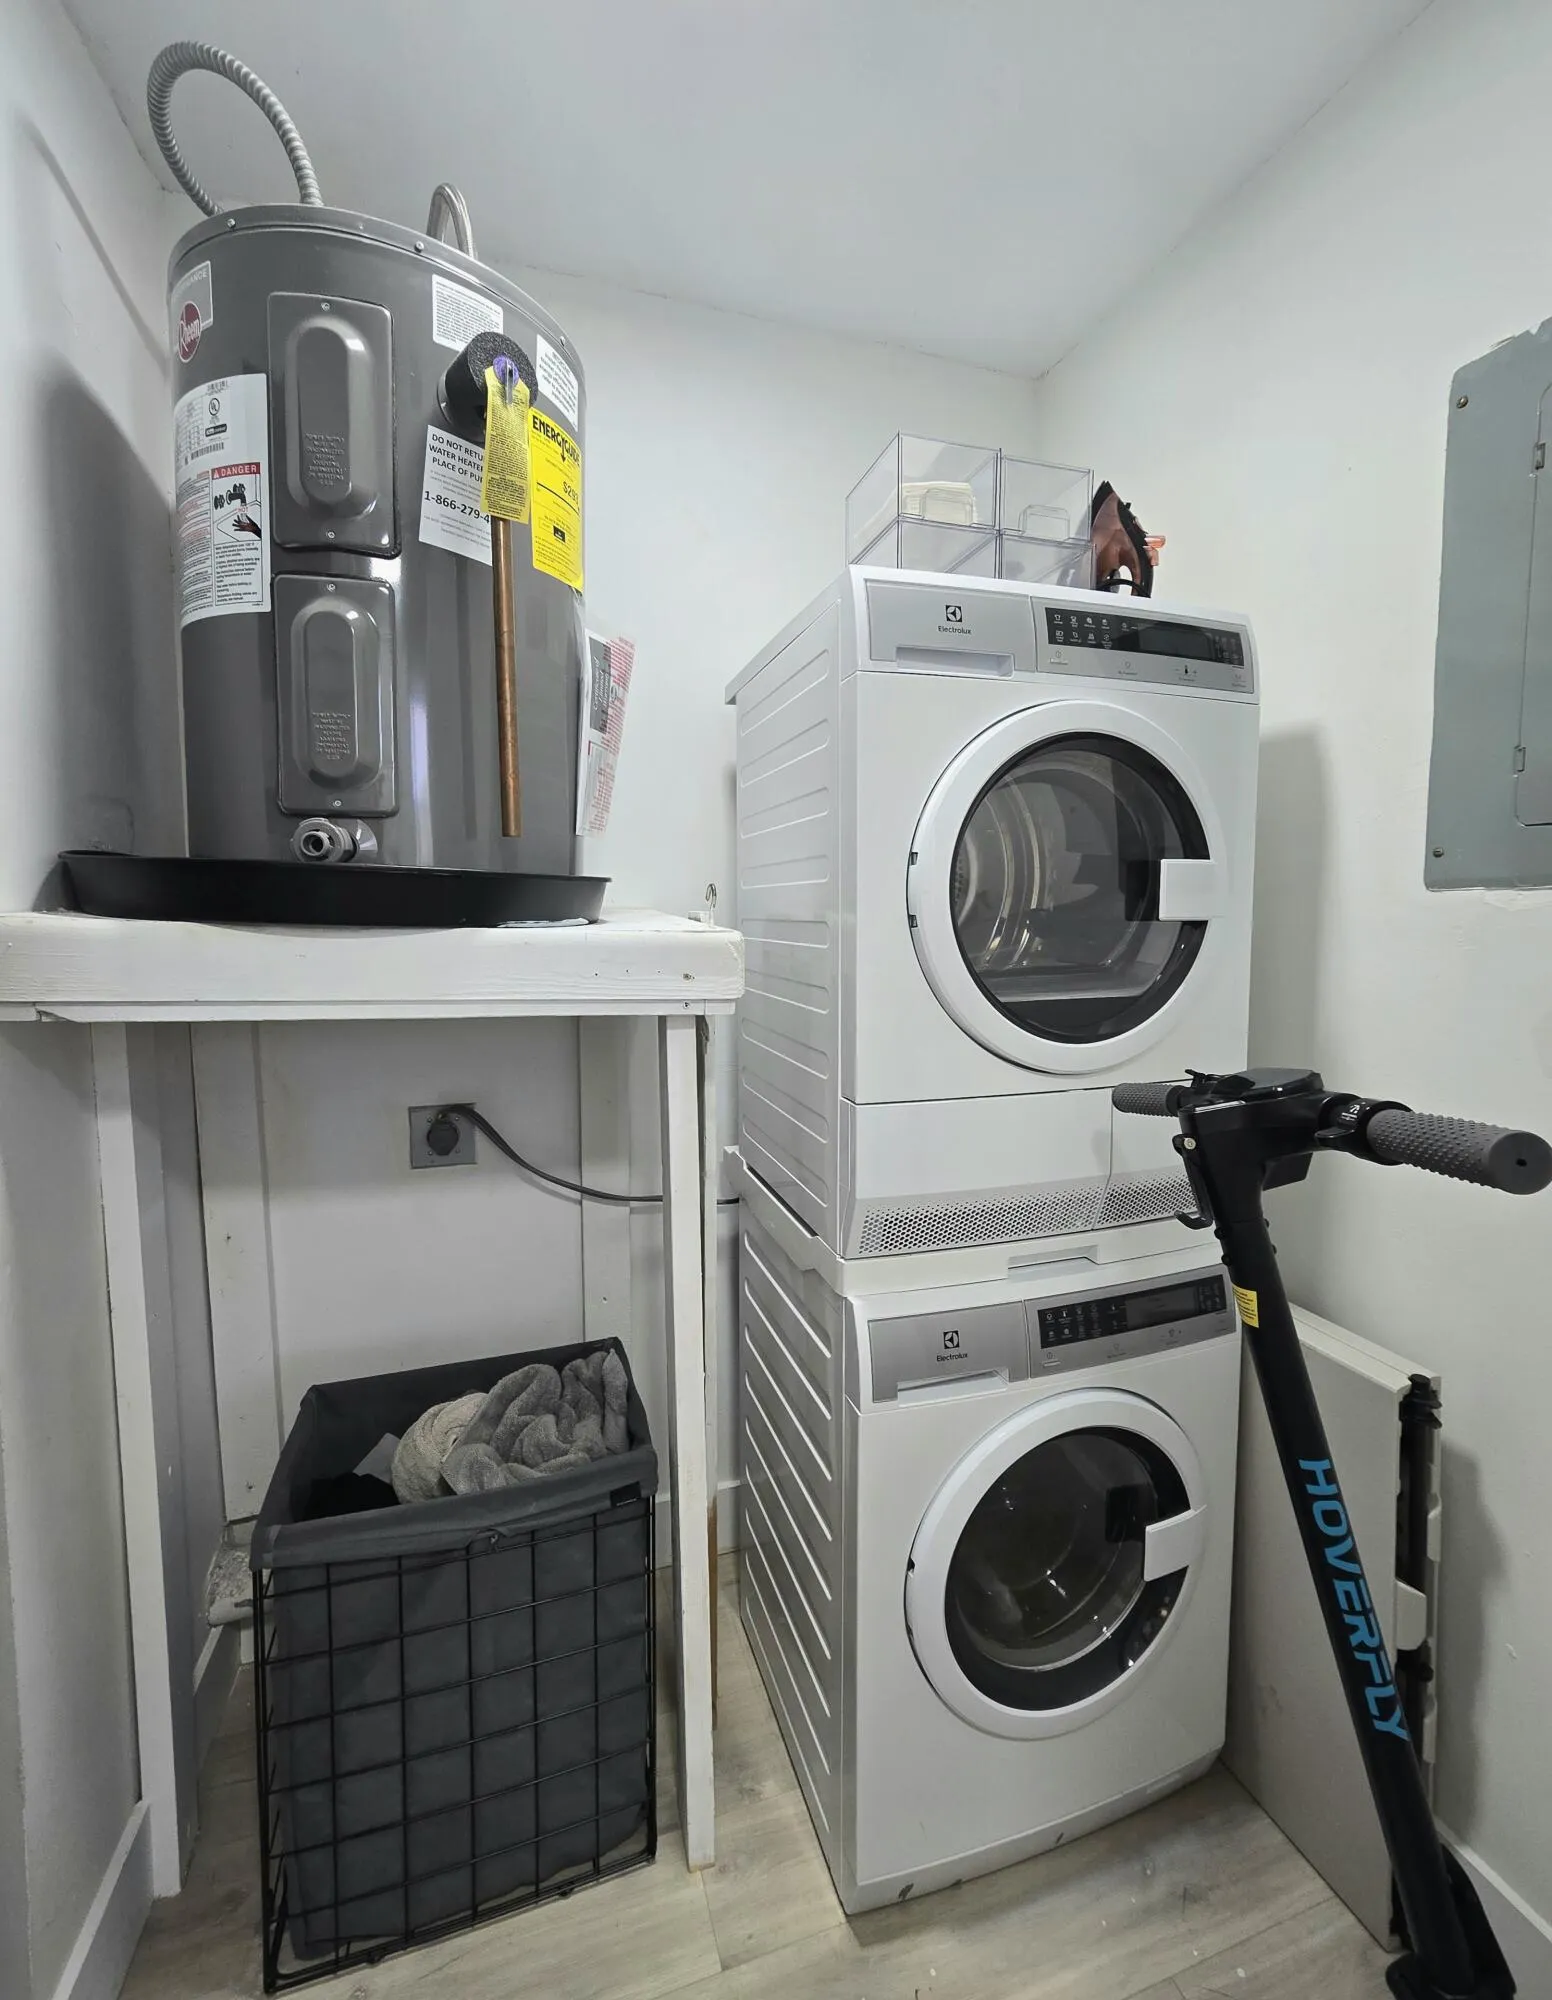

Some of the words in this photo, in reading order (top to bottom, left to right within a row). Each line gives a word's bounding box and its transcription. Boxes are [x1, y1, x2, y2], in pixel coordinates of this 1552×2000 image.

[429, 443, 456, 461] WATER
[432, 433, 445, 444] DO
[446, 439, 463, 452] NOT
[464, 447, 484, 461] RETU
[221, 464, 257, 477] DANGER
[432, 456, 457, 472] PLACE
[457, 467, 469, 477] OF
[469, 472, 483, 484] PU
[424, 490, 490, 524] 1-866-279-4
[937, 625, 971, 635] Electrolux
[936, 1353, 969, 1362] Electrolux
[1298, 1458, 1411, 1742] HOVERFLY
